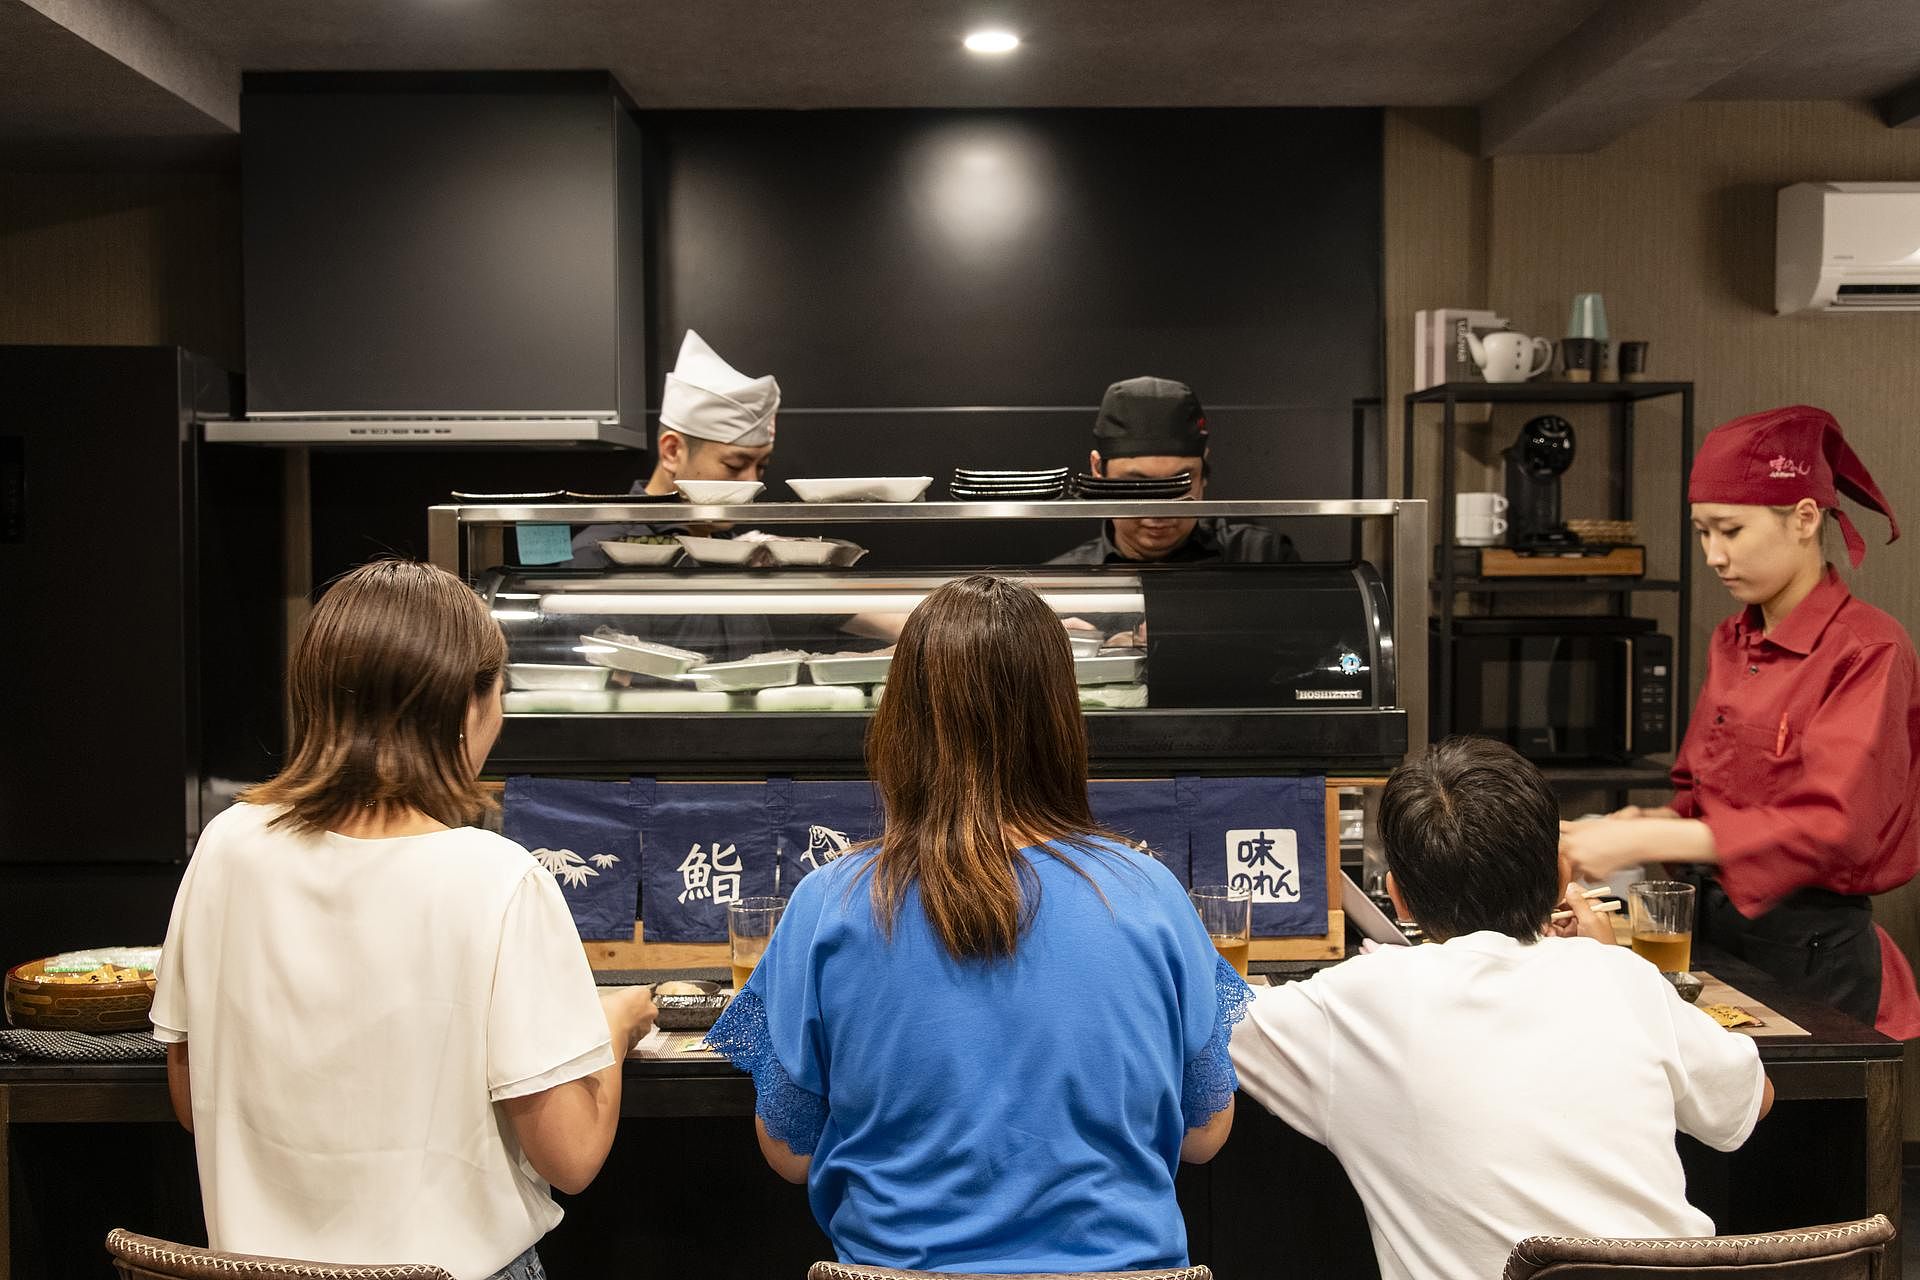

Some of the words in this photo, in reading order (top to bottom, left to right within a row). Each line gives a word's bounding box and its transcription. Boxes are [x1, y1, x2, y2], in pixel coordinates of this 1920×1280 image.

[1237, 831, 1285, 869] 味
[676, 842, 743, 905] 鮨
[1231, 870, 1299, 899] のれん
